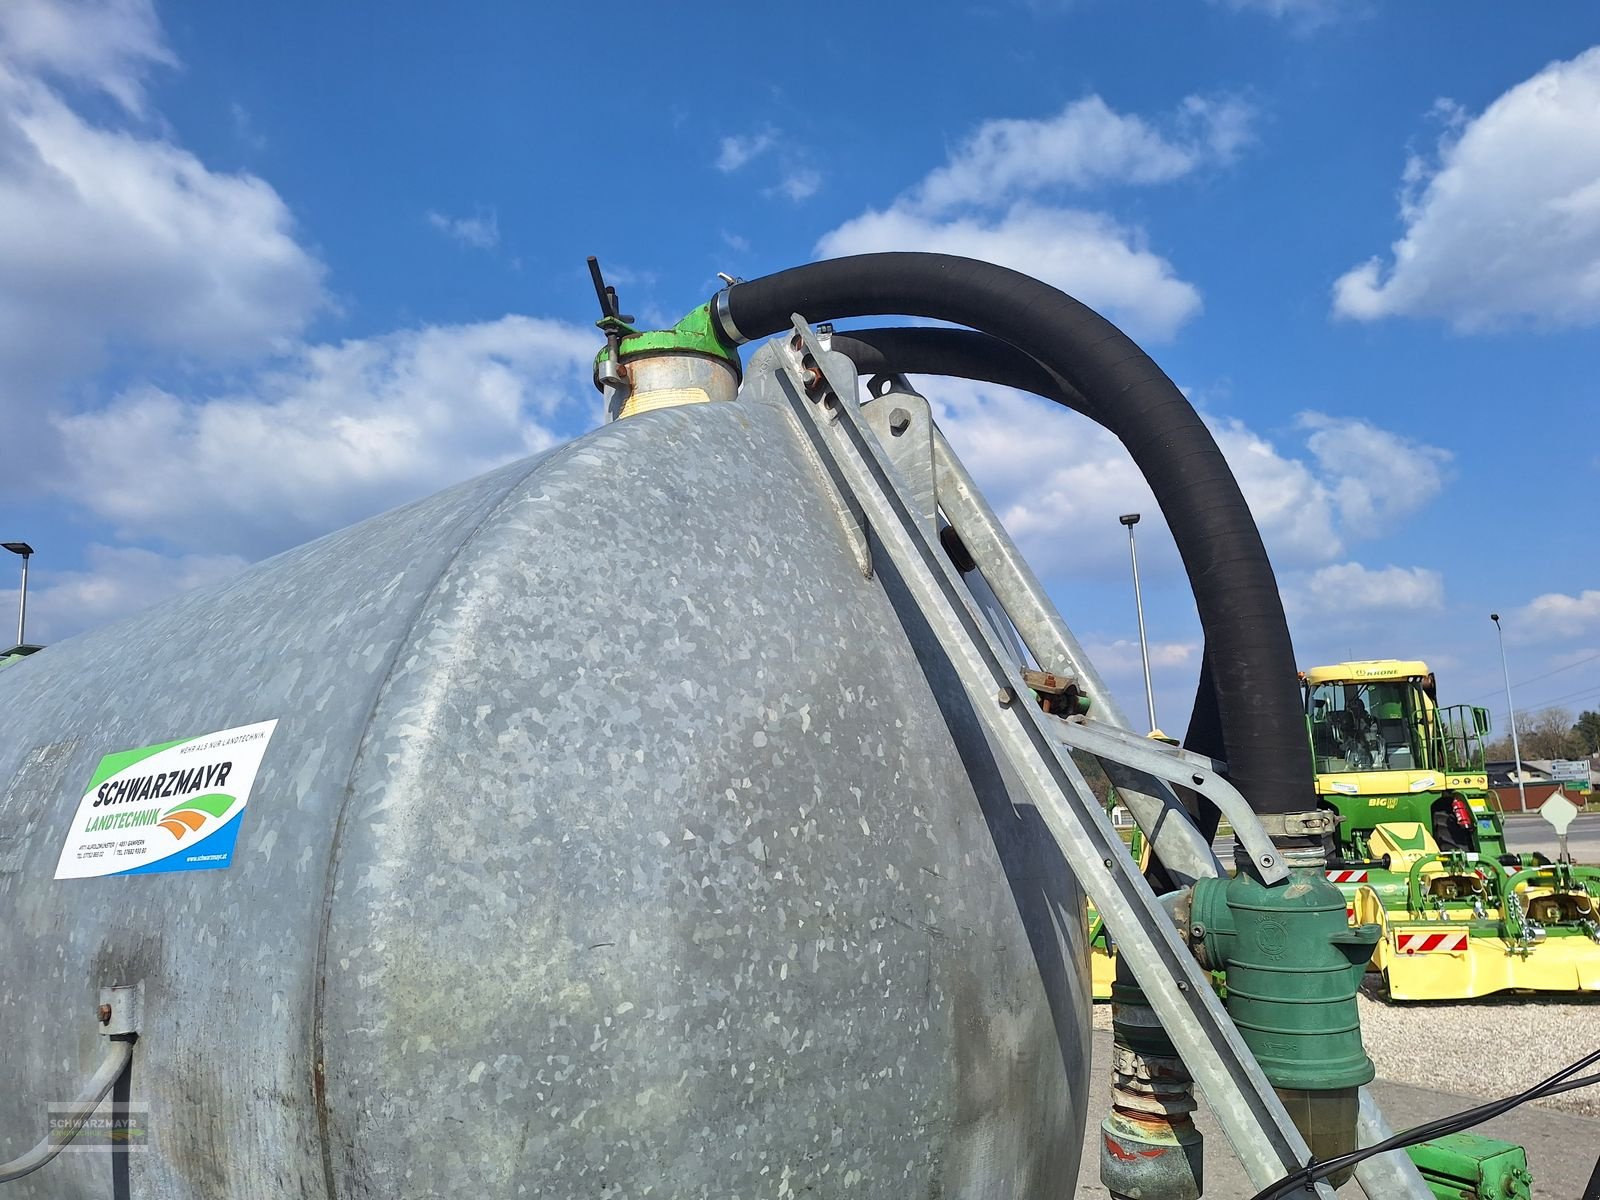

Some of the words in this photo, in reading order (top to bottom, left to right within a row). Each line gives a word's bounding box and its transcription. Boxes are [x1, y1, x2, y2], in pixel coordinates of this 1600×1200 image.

[1366, 669, 1399, 677] KRONE
[180, 745, 196, 754] MEHR
[196, 742, 209, 751] ALS
[92, 761, 233, 808] SCHWARZMAYR
[84, 807, 162, 833] LANDTECHNIK
